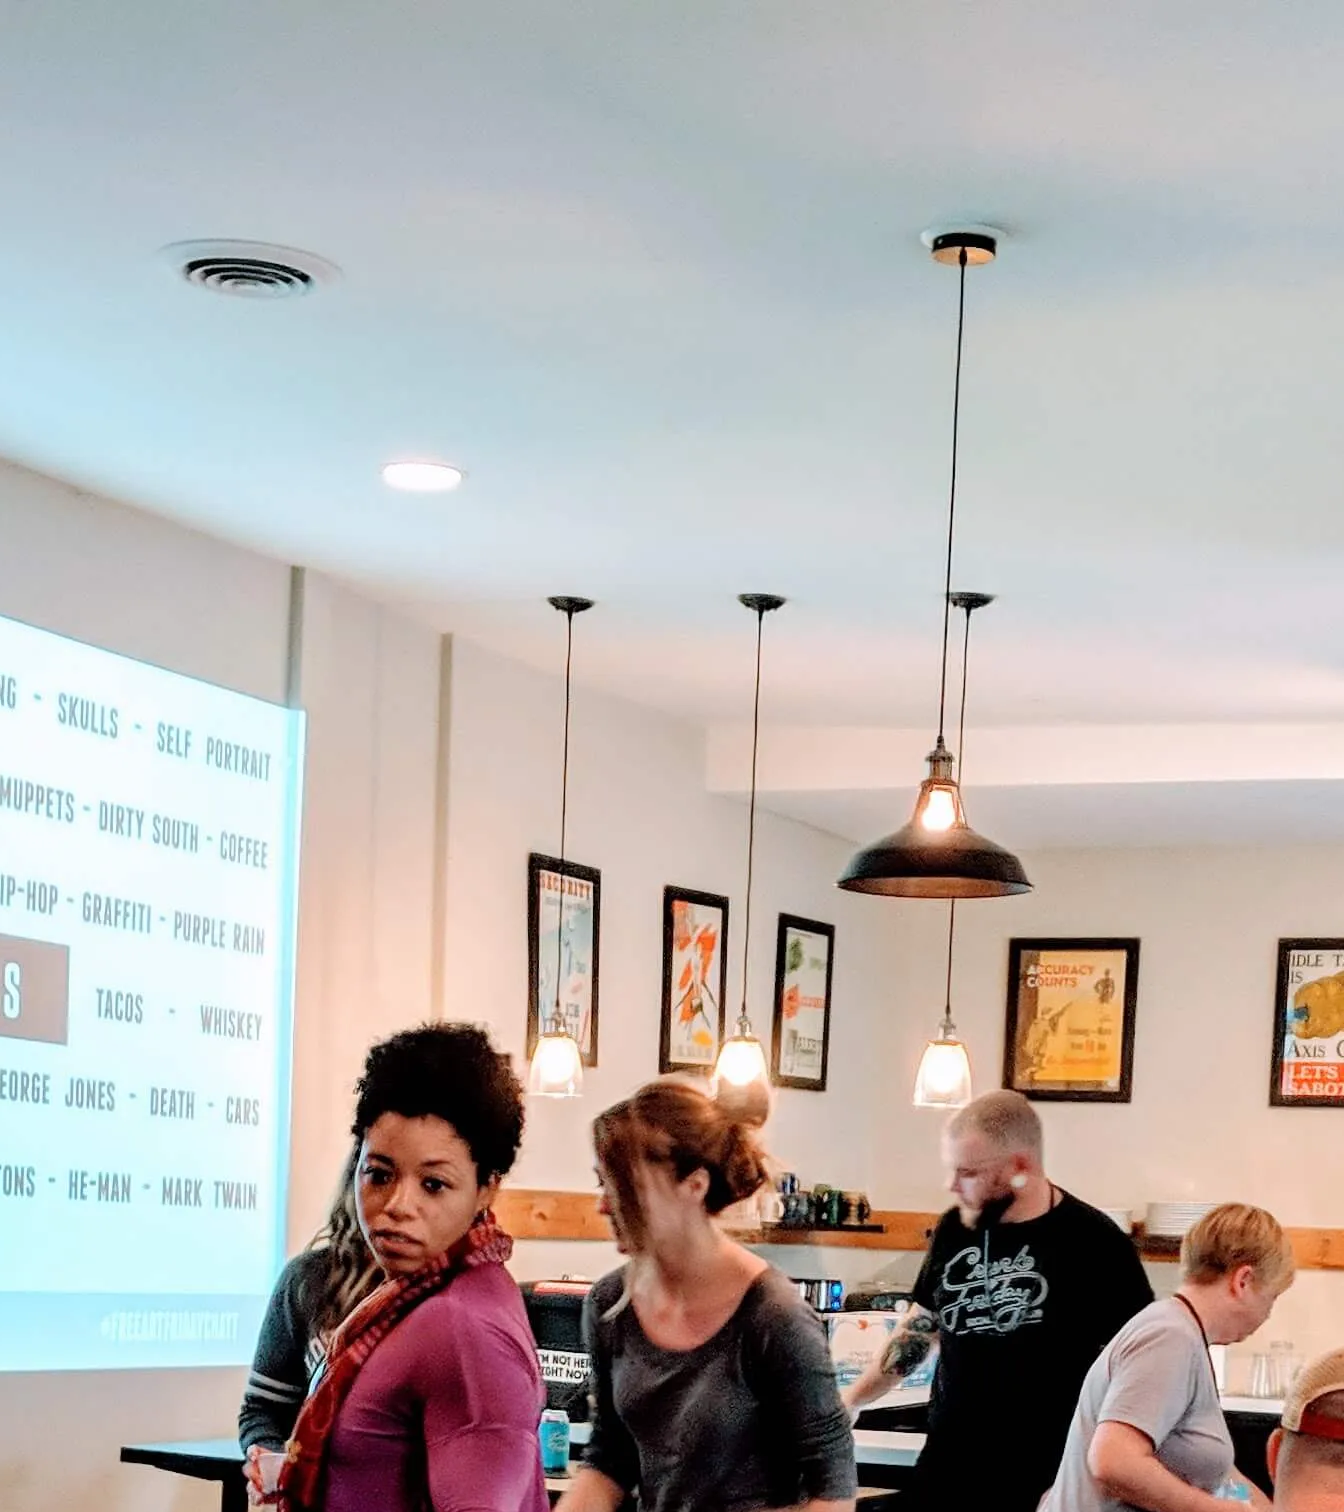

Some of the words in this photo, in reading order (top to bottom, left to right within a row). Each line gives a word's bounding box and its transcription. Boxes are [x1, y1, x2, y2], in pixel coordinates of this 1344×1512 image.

[58, 693, 118, 739] SKULLS
[157, 722, 192, 759] SELF
[207, 736, 271, 782] PORTRAIT
[0, 775, 74, 823] MUPPETS
[99, 800, 144, 840] DIRTY
[153, 814, 198, 853] SOUTH
[220, 830, 268, 869] COFFEE
[82, 892, 151, 934] GRAFFITI
[174, 911, 225, 948] PURPLE
[233, 924, 265, 956] RAIN
[1027, 963, 1095, 977] ACCURACY
[1290, 953, 1324, 968] IDLE
[1027, 976, 1080, 989] COUNTS
[1290, 972, 1304, 984] IS
[96, 988, 143, 1024] TACOS
[200, 1004, 262, 1041] WHISKEY
[1288, 1064, 1339, 1079] LET'S
[65, 1077, 115, 1112] JONES
[150, 1087, 195, 1120] DEATH
[226, 1096, 260, 1127] CARS
[68, 1170, 131, 1204] HE-MAN
[161, 1177, 202, 1207] MARK
[214, 1181, 257, 1211] TWAIN
[552, 1355, 571, 1366] NOT
